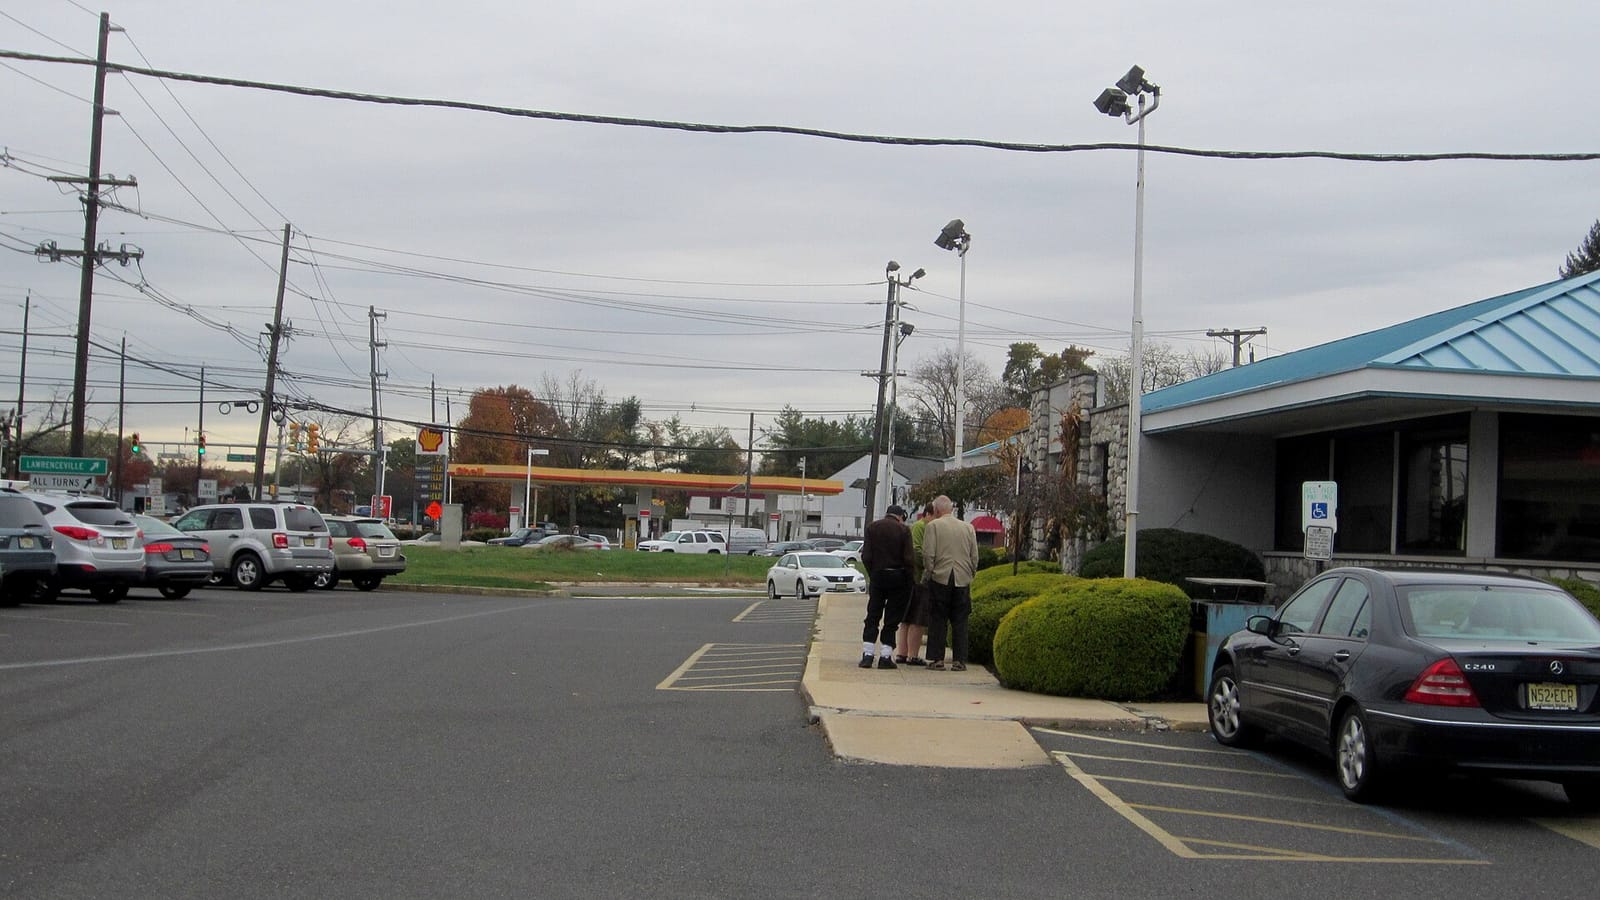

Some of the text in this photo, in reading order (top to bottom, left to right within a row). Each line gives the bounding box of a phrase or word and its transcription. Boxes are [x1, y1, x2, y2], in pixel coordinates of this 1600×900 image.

[26, 460, 84, 471] LAWRENCEVILLE
[455, 466, 485, 476] Shell
[33, 477, 80, 487] ALL TURNS
